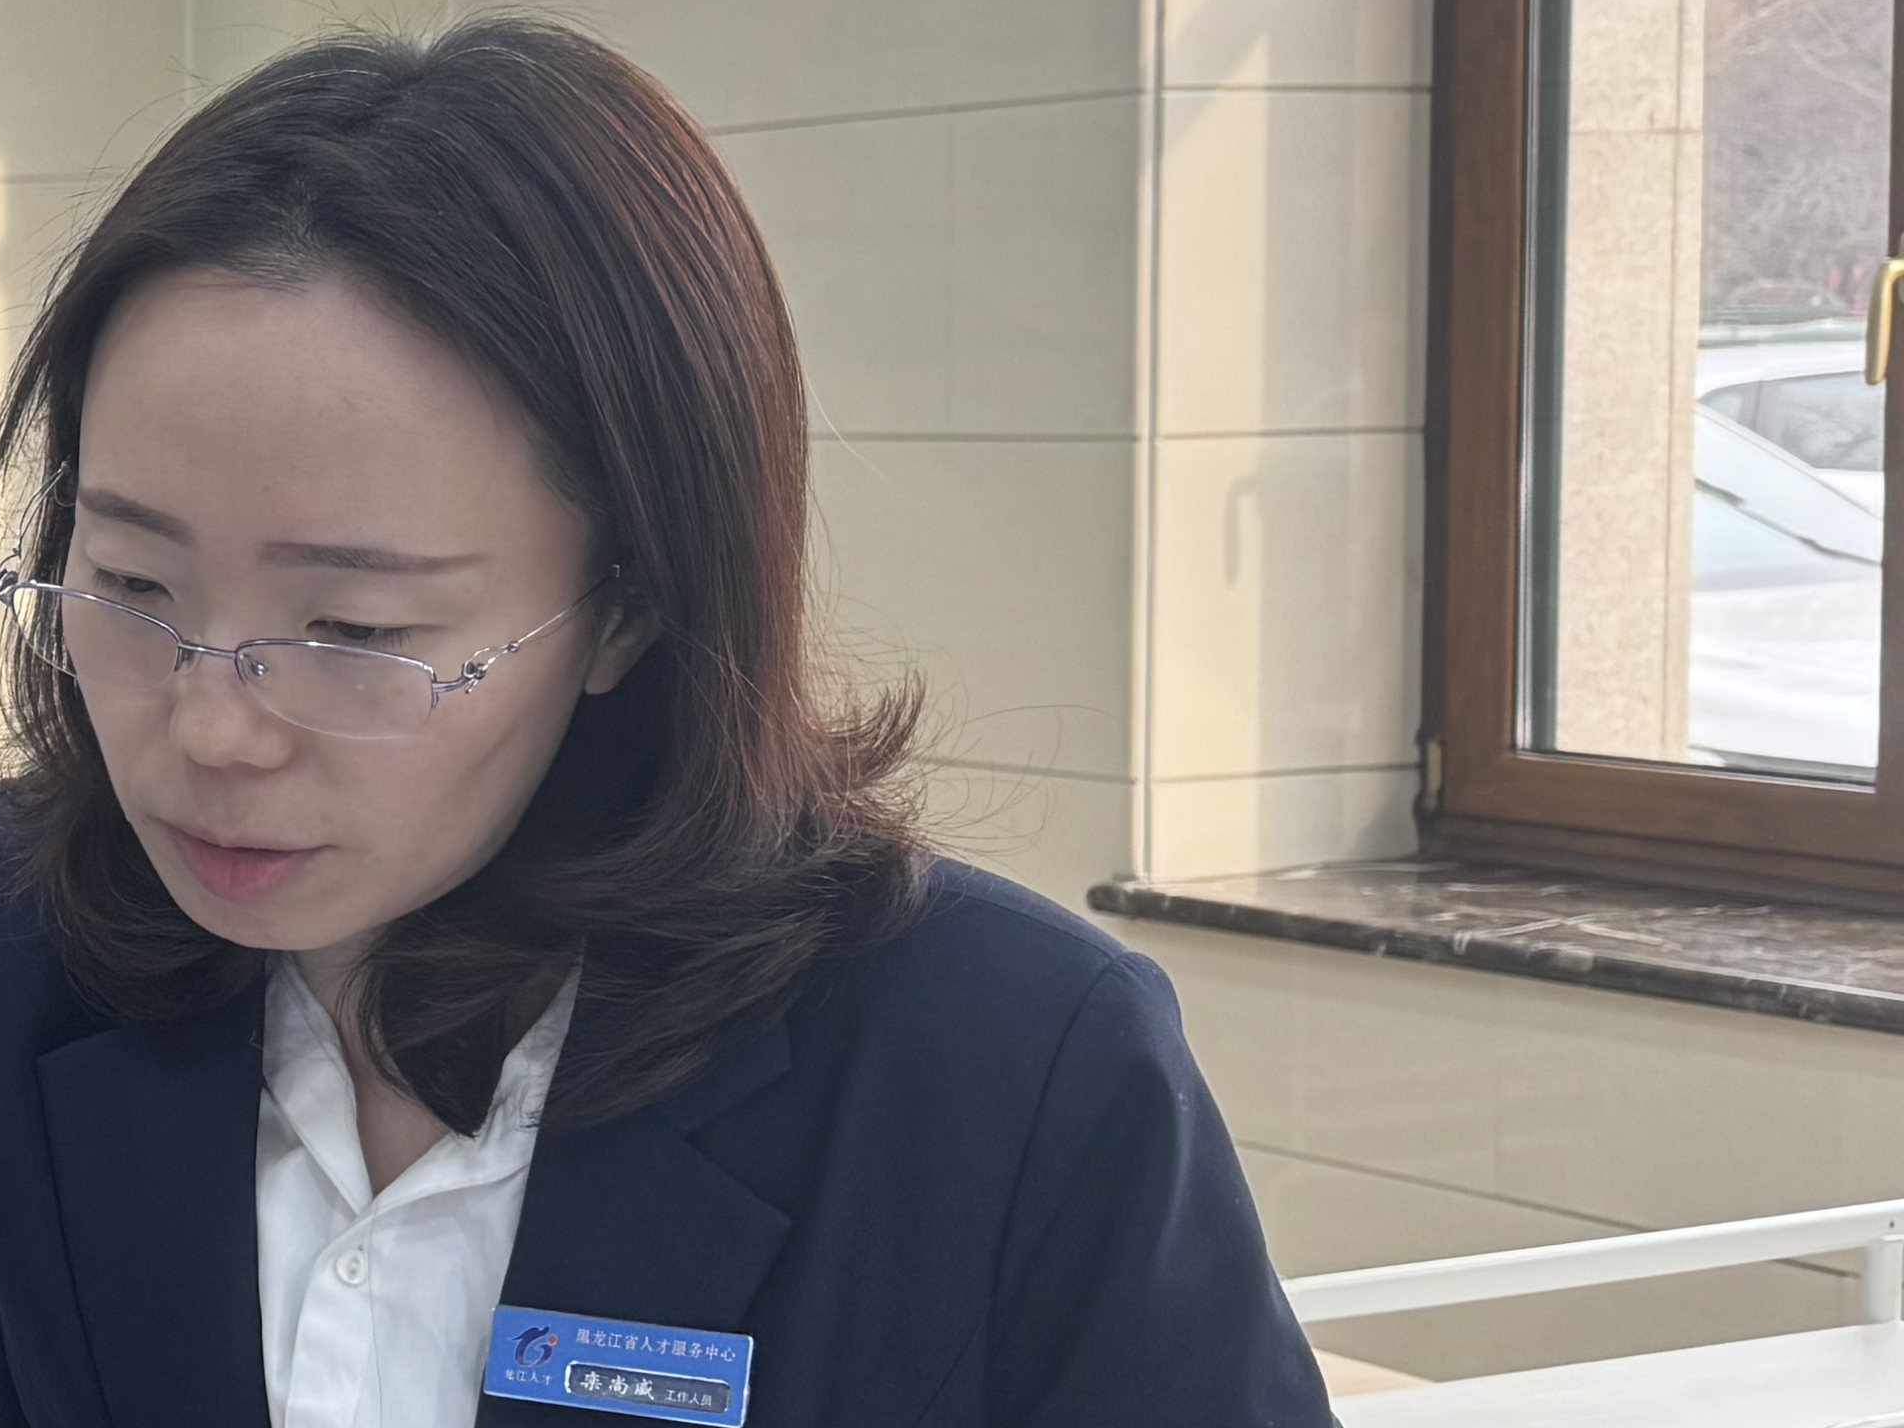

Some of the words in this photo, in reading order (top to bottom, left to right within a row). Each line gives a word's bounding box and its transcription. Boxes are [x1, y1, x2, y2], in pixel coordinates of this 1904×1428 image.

[576, 1328, 737, 1362] 黑龙江省人才服务中心
[664, 1389, 713, 1407] 工作人员
